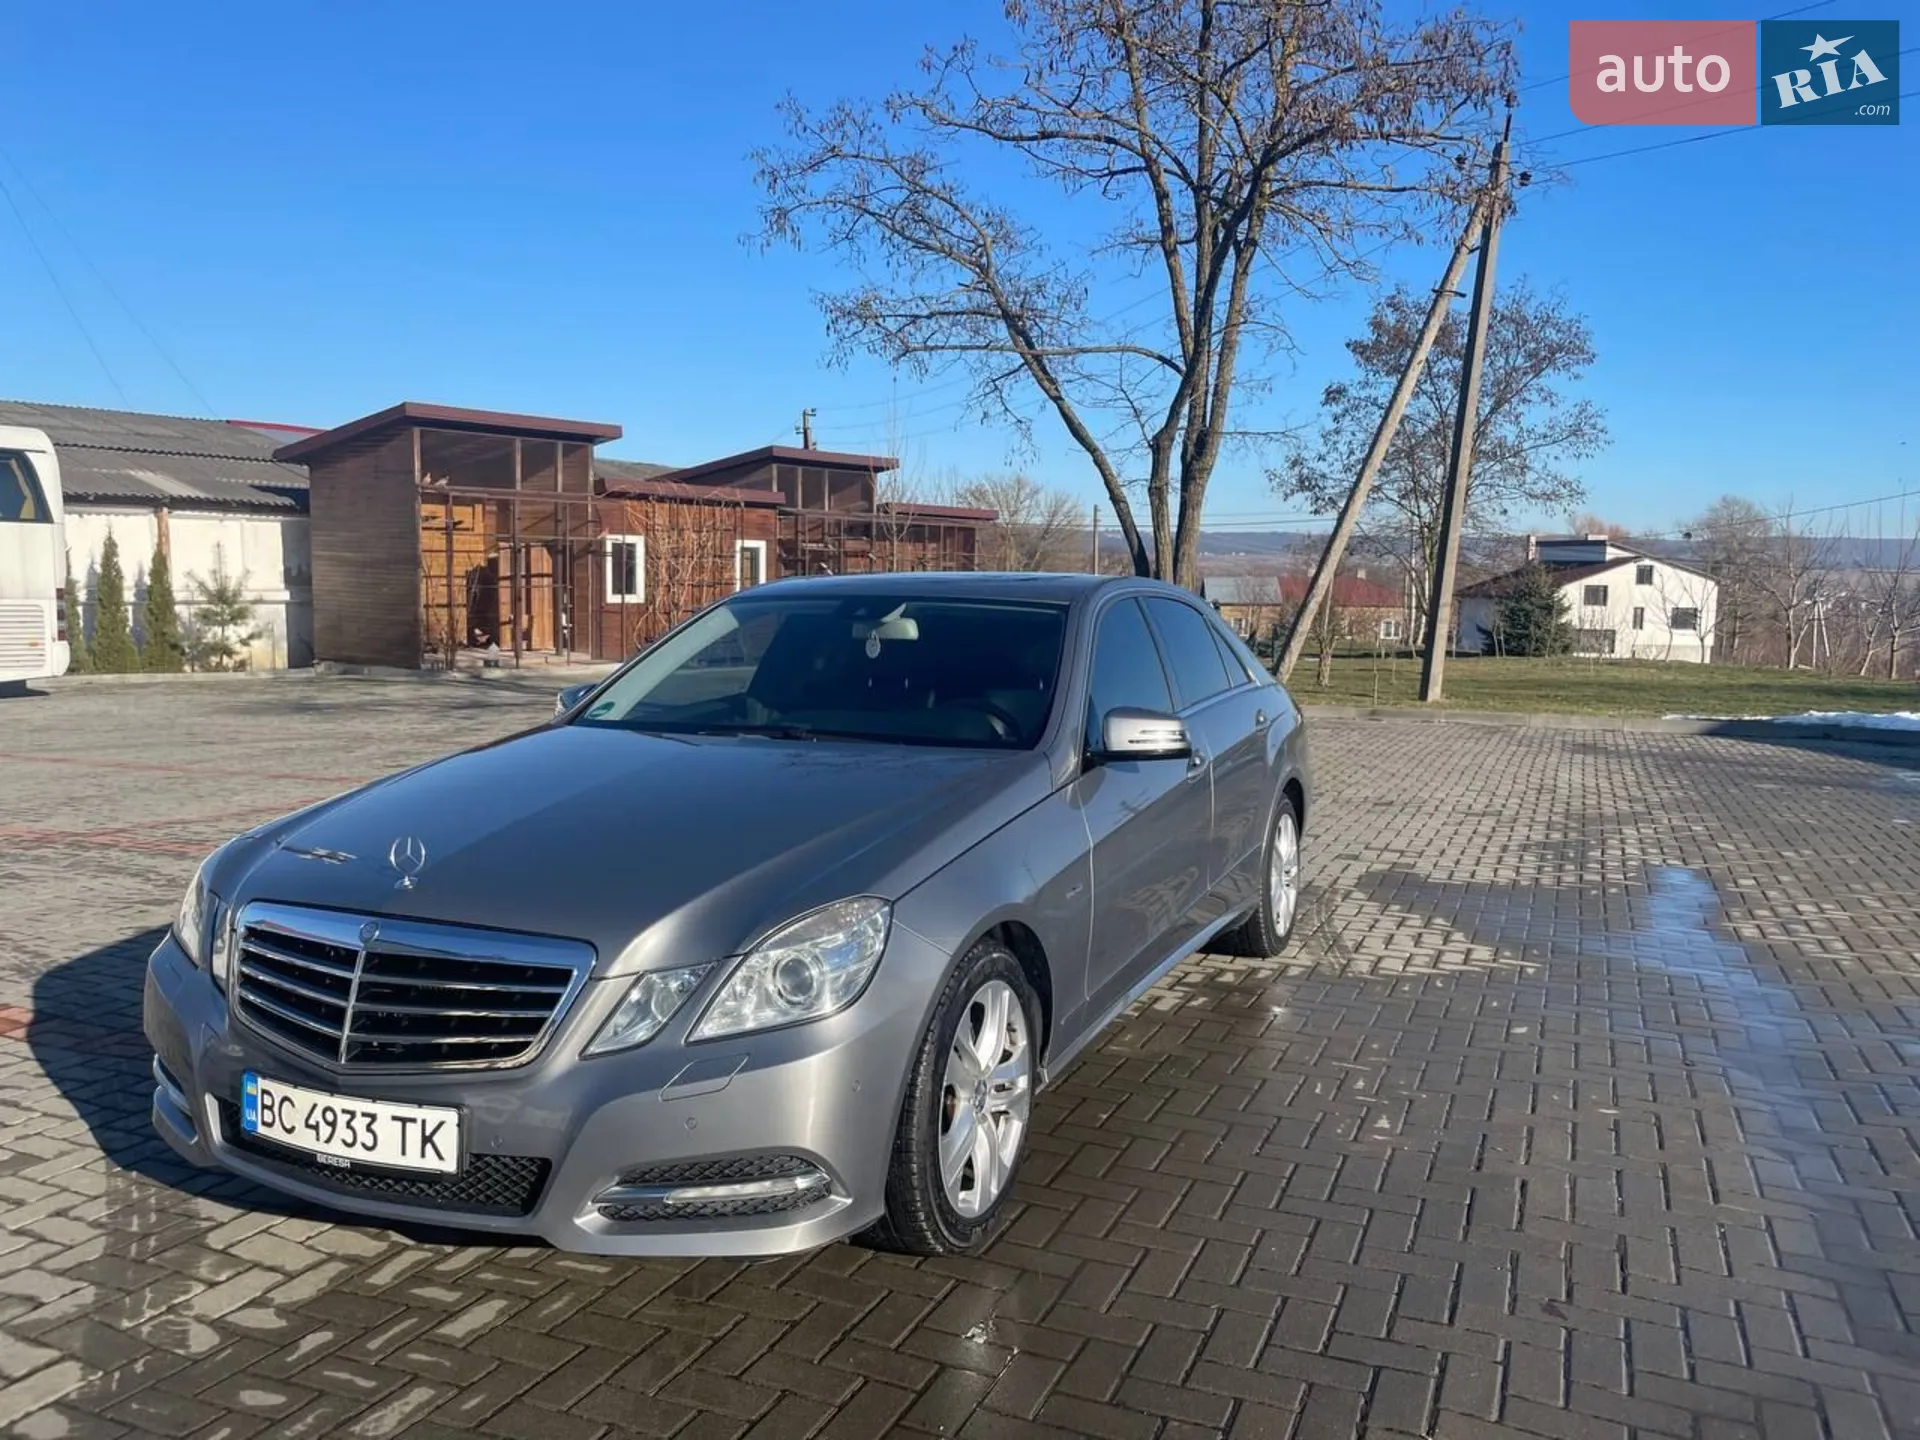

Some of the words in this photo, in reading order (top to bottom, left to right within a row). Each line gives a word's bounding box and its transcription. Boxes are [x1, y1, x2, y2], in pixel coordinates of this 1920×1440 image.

[260, 1089, 296, 1135] BC
[304, 1102, 378, 1152] 4933
[391, 1115, 446, 1162] TK
